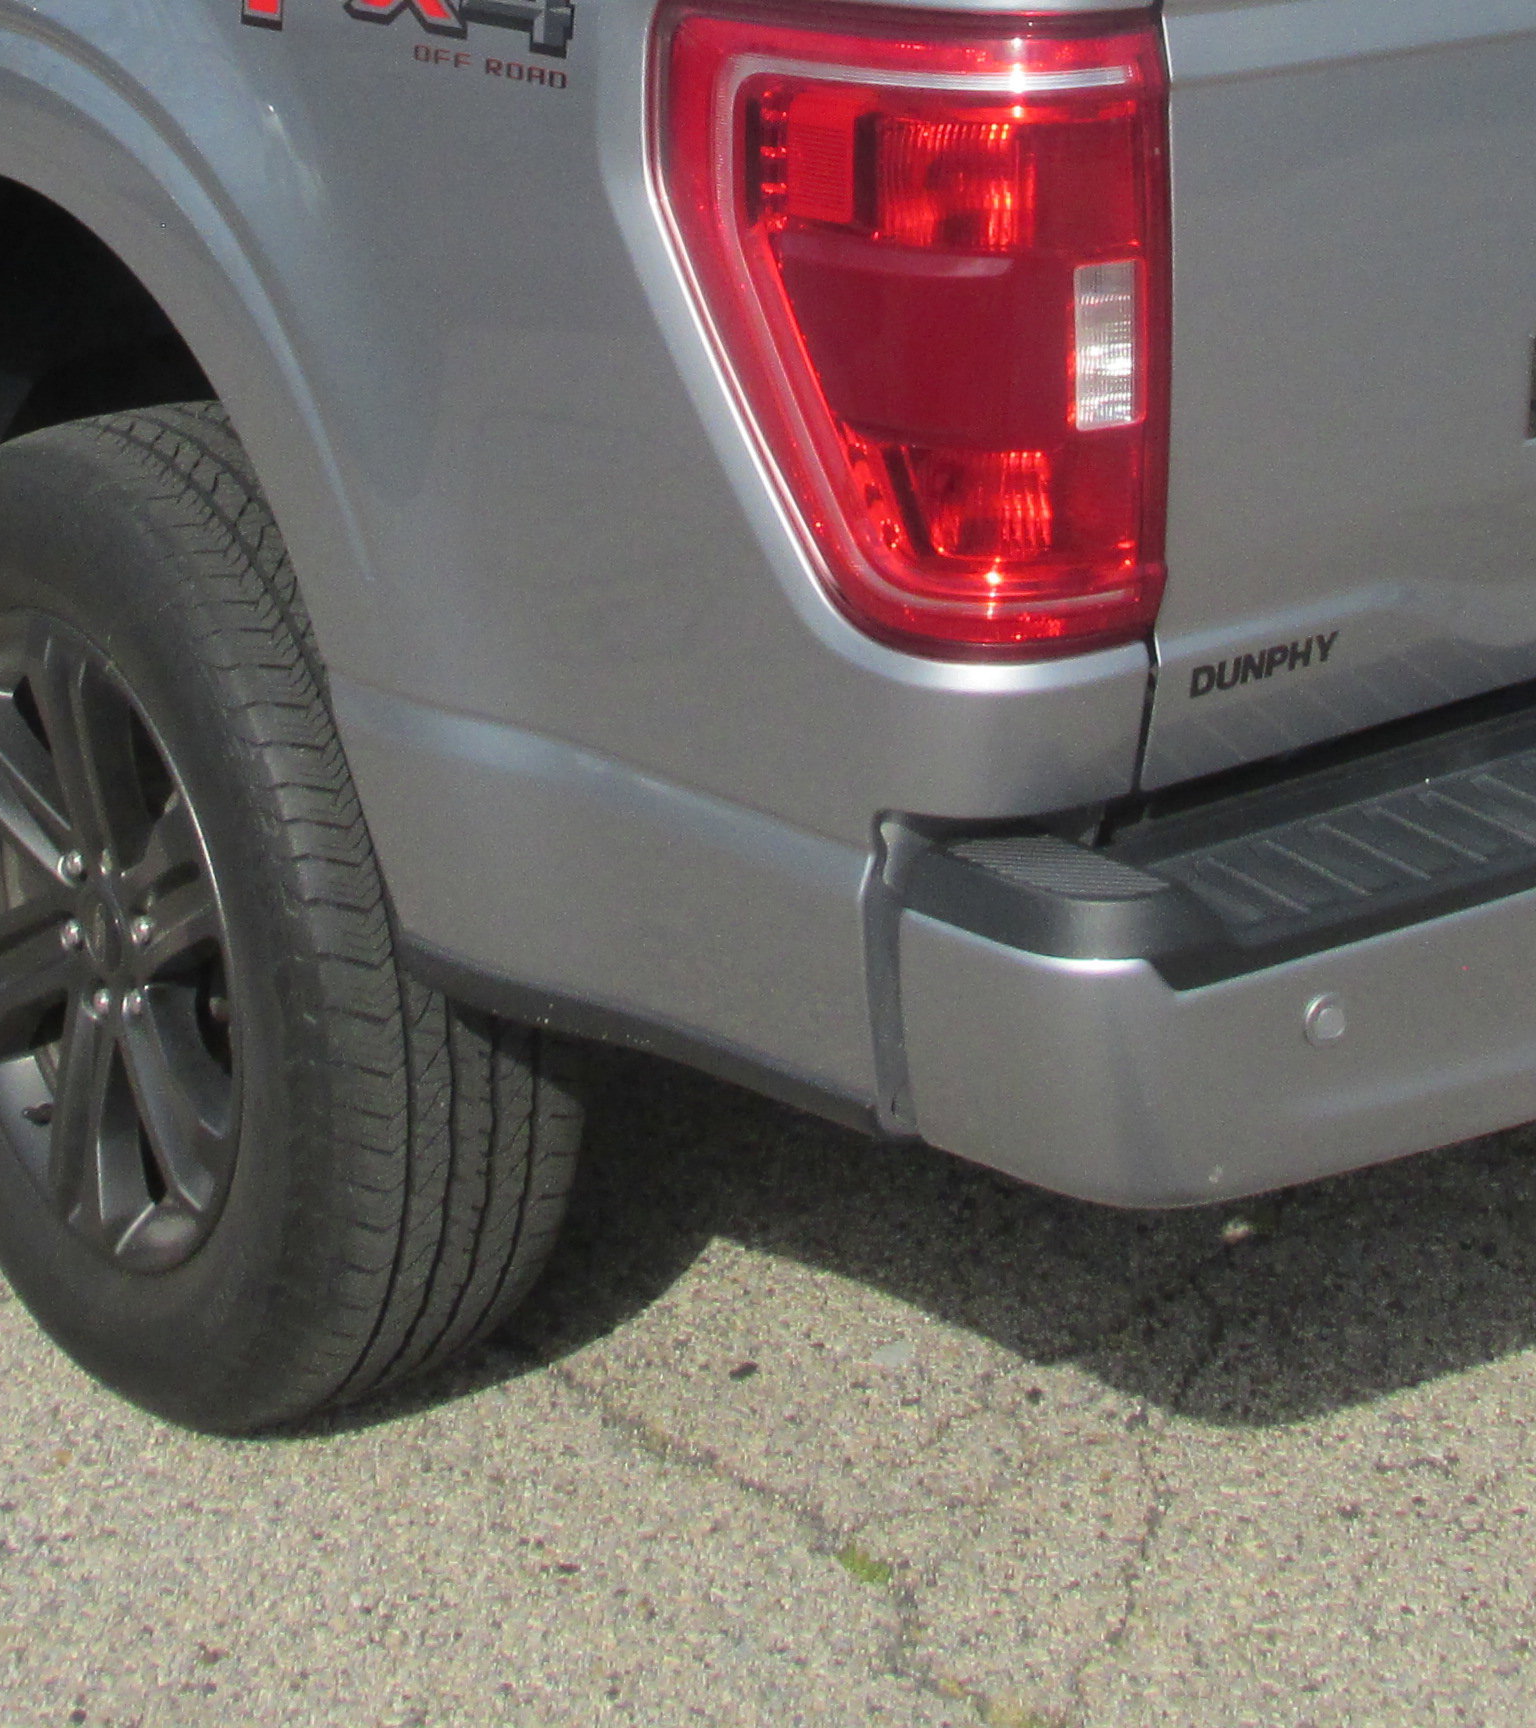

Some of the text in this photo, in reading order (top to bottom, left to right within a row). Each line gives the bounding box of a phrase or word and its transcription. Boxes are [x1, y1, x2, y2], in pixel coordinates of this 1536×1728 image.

[414, 44, 569, 89] OFF ROAD
[1189, 629, 1339, 698] DUNPHY
